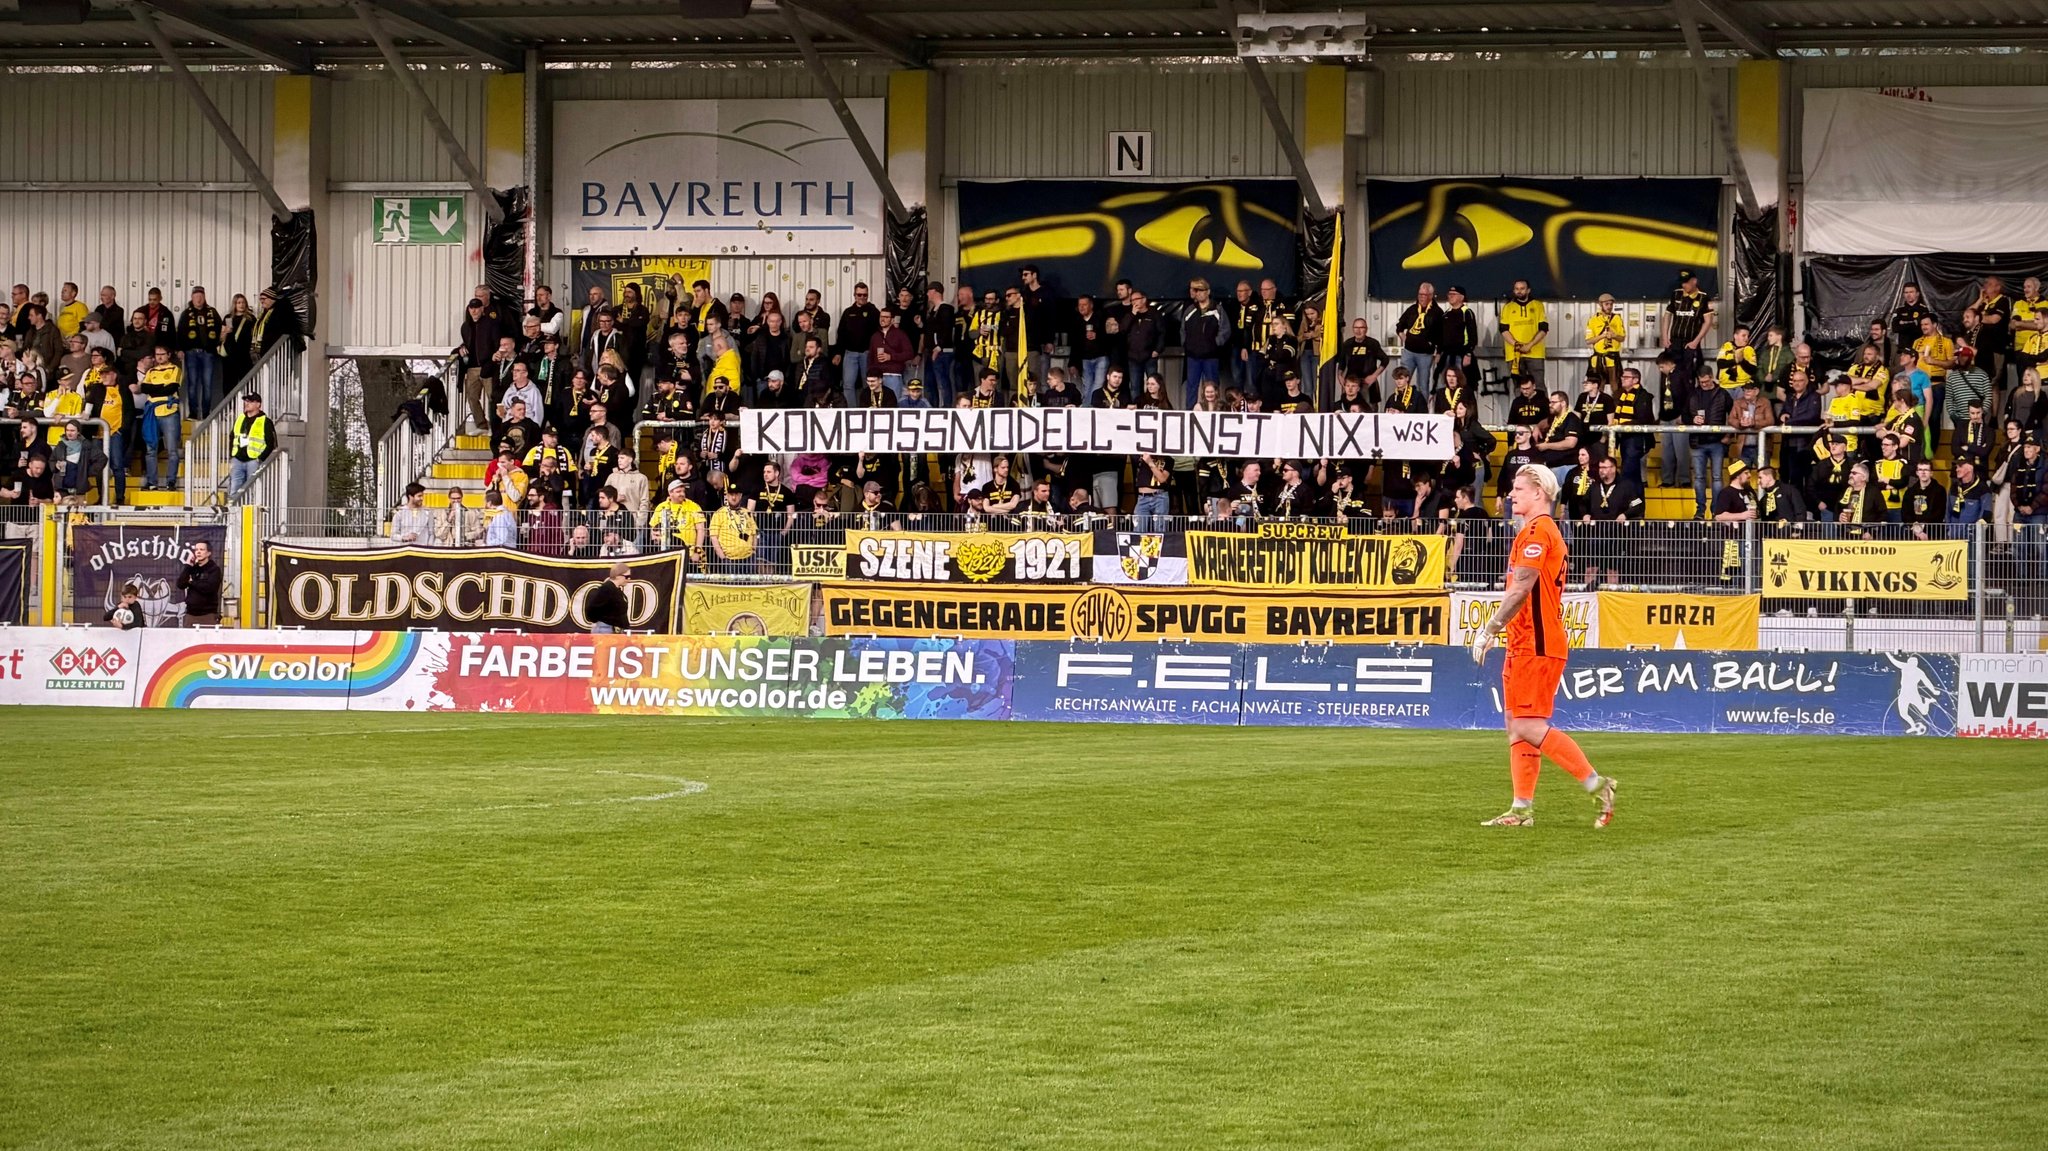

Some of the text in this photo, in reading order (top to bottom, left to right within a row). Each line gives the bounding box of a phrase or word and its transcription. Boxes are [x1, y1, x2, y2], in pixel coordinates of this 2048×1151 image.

[1118, 136, 1143, 170] N
[582, 181, 854, 230] BAYREUTH
[580, 256, 707, 271] ALTSTADT KULT
[1299, 413, 1384, 459] NIX!
[1393, 421, 1439, 445] WSK
[1262, 524, 1343, 539] SUPCREW
[799, 550, 840, 567] USK
[859, 537, 1081, 580] SZENE 1921
[1190, 535, 1391, 585] WAGNERSTADT KOLLEKTIV
[1819, 546, 1896, 555] OLDSCHDOD
[796, 566, 843, 574] ABSCHAFFEN
[967, 555, 998, 572] 1921
[1798, 570, 1918, 593] VIKINGS
[830, 597, 1065, 632] GEGENGERADE
[1136, 604, 1441, 636] SPVGG BAYREUTH
[1647, 604, 1715, 625] FORZA
[58, 652, 121, 671] BHG
[207, 654, 352, 681] SW color
[459, 645, 986, 684] FARBE IST UNSER LEBEN.
[1966, 655, 2043, 673] Immer in
[48, 681, 123, 689] BAUZENTRUM
[1637, 661, 1699, 694] AM
[1713, 661, 1838, 693] BALL!
[591, 683, 846, 710] www.swcolor.de
[1055, 697, 1177, 713] RECHTSANWÄLTE
[1192, 698, 1302, 716] FACHANWÄLTE
[1317, 702, 1430, 718] STEUERBERATER
[1726, 707, 1835, 725] www.fe-ls.de
